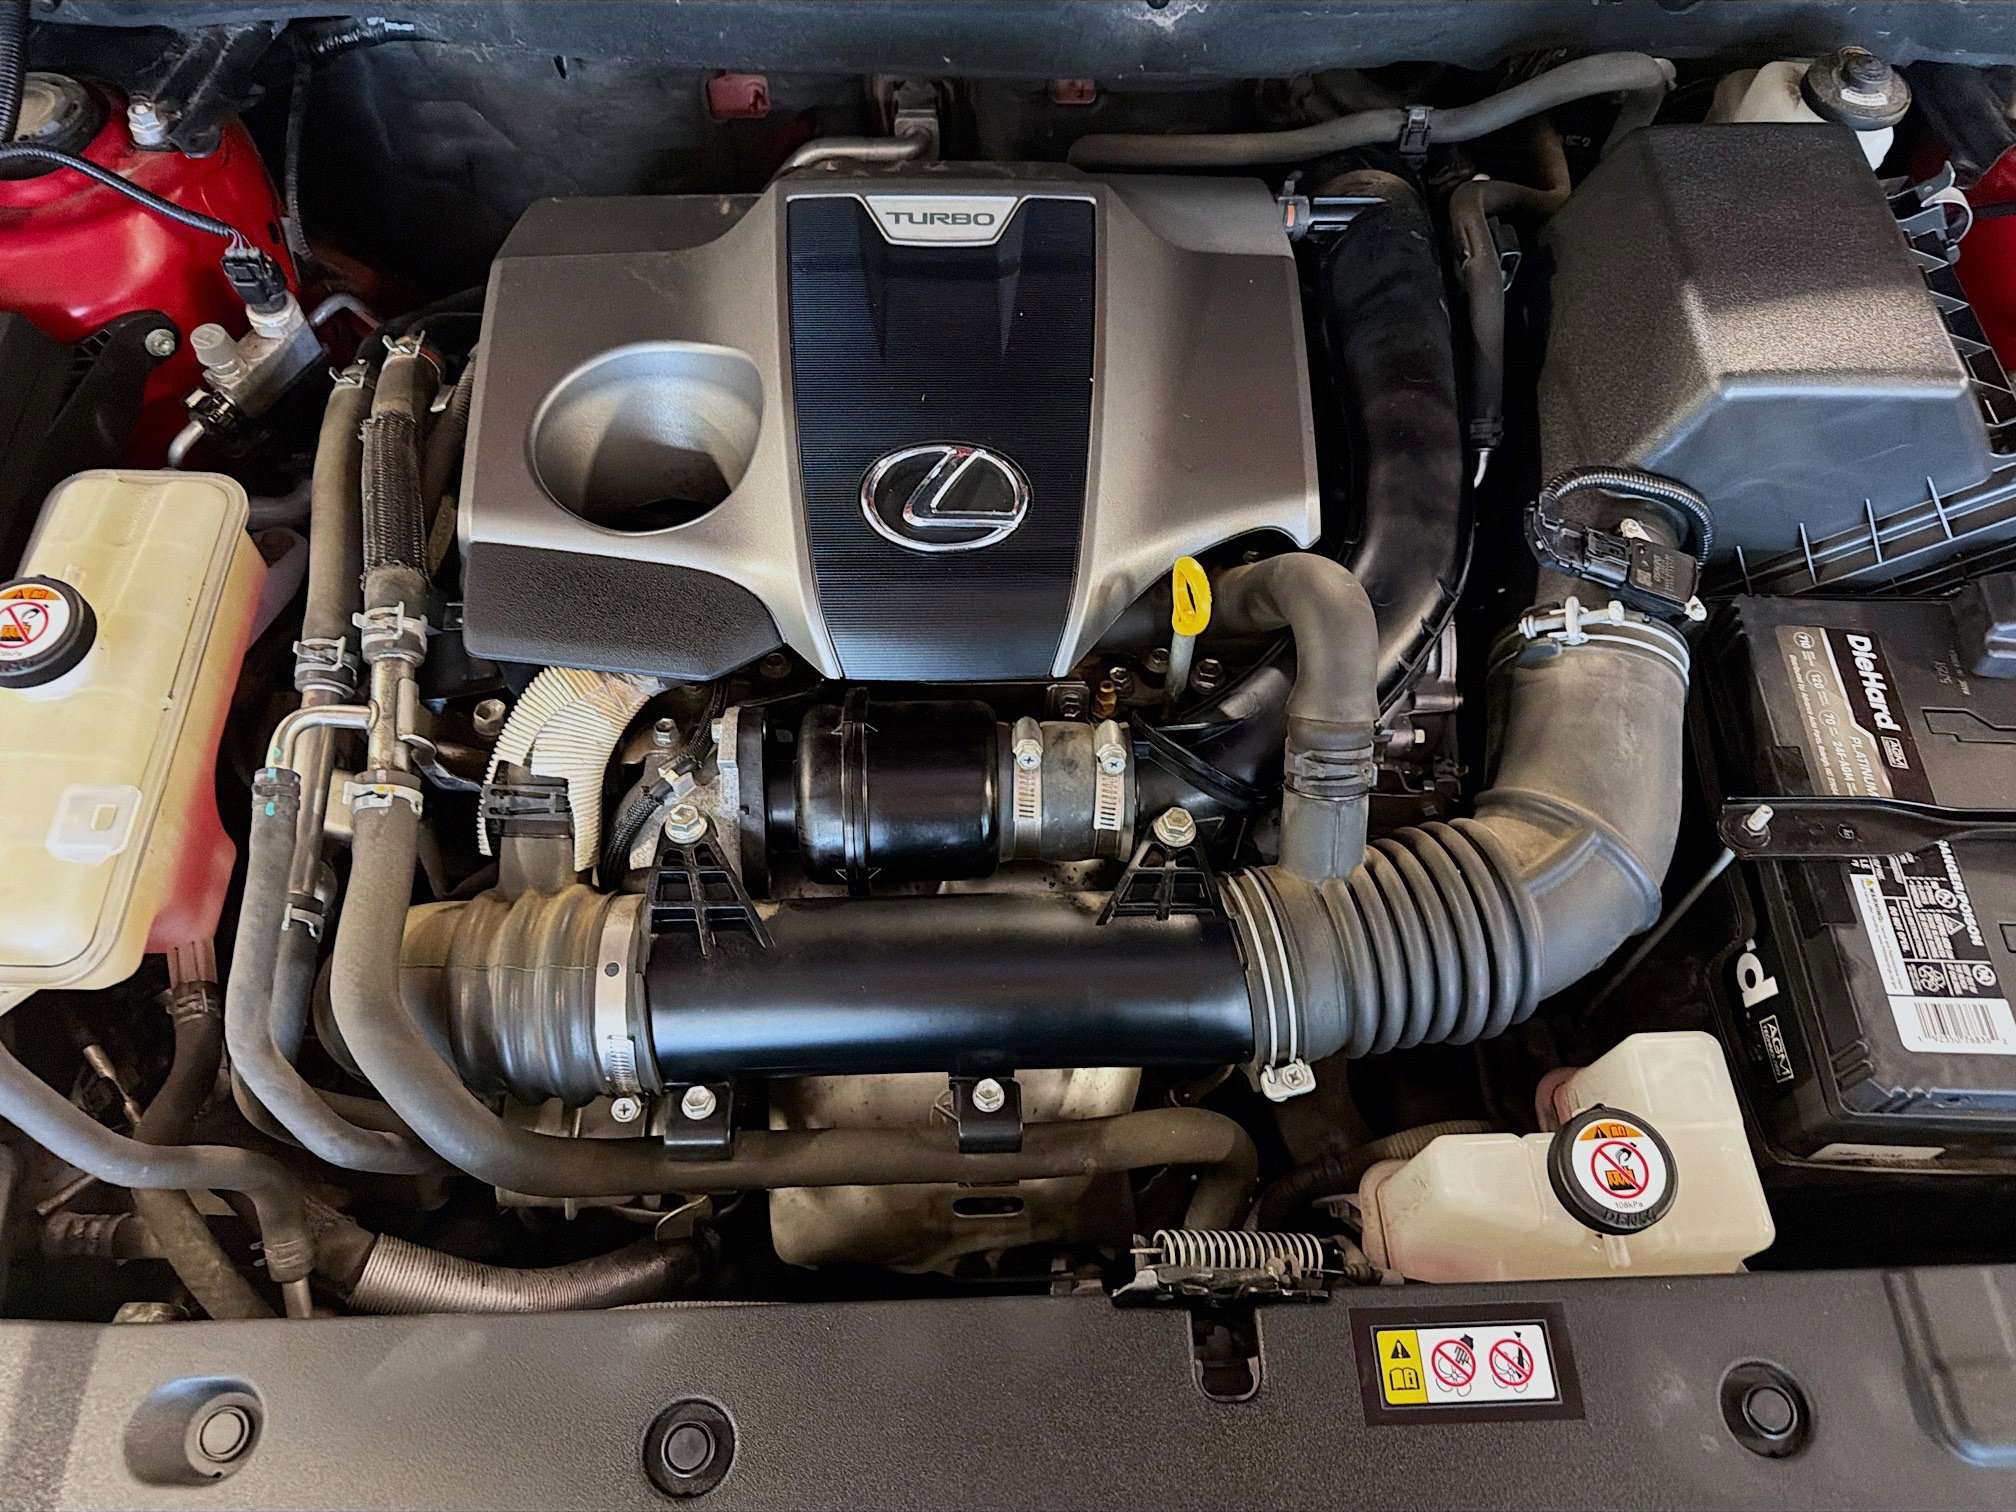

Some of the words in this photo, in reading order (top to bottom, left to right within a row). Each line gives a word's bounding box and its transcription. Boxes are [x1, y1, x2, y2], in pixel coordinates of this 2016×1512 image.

[886, 211, 994, 227] TURBO
[1797, 634, 1811, 649] 710
[1809, 673, 1824, 688] 120
[1845, 633, 1902, 731] DieHard
[1822, 712, 1836, 725] 70
[1831, 740, 1855, 782] 24F-AGM
[1887, 739, 1904, 765] AGM
[1848, 735, 1880, 797] PLATINUM
[1766, 1020, 1790, 1076] AGM
[1614, 1201, 1644, 1209] 108kPa
